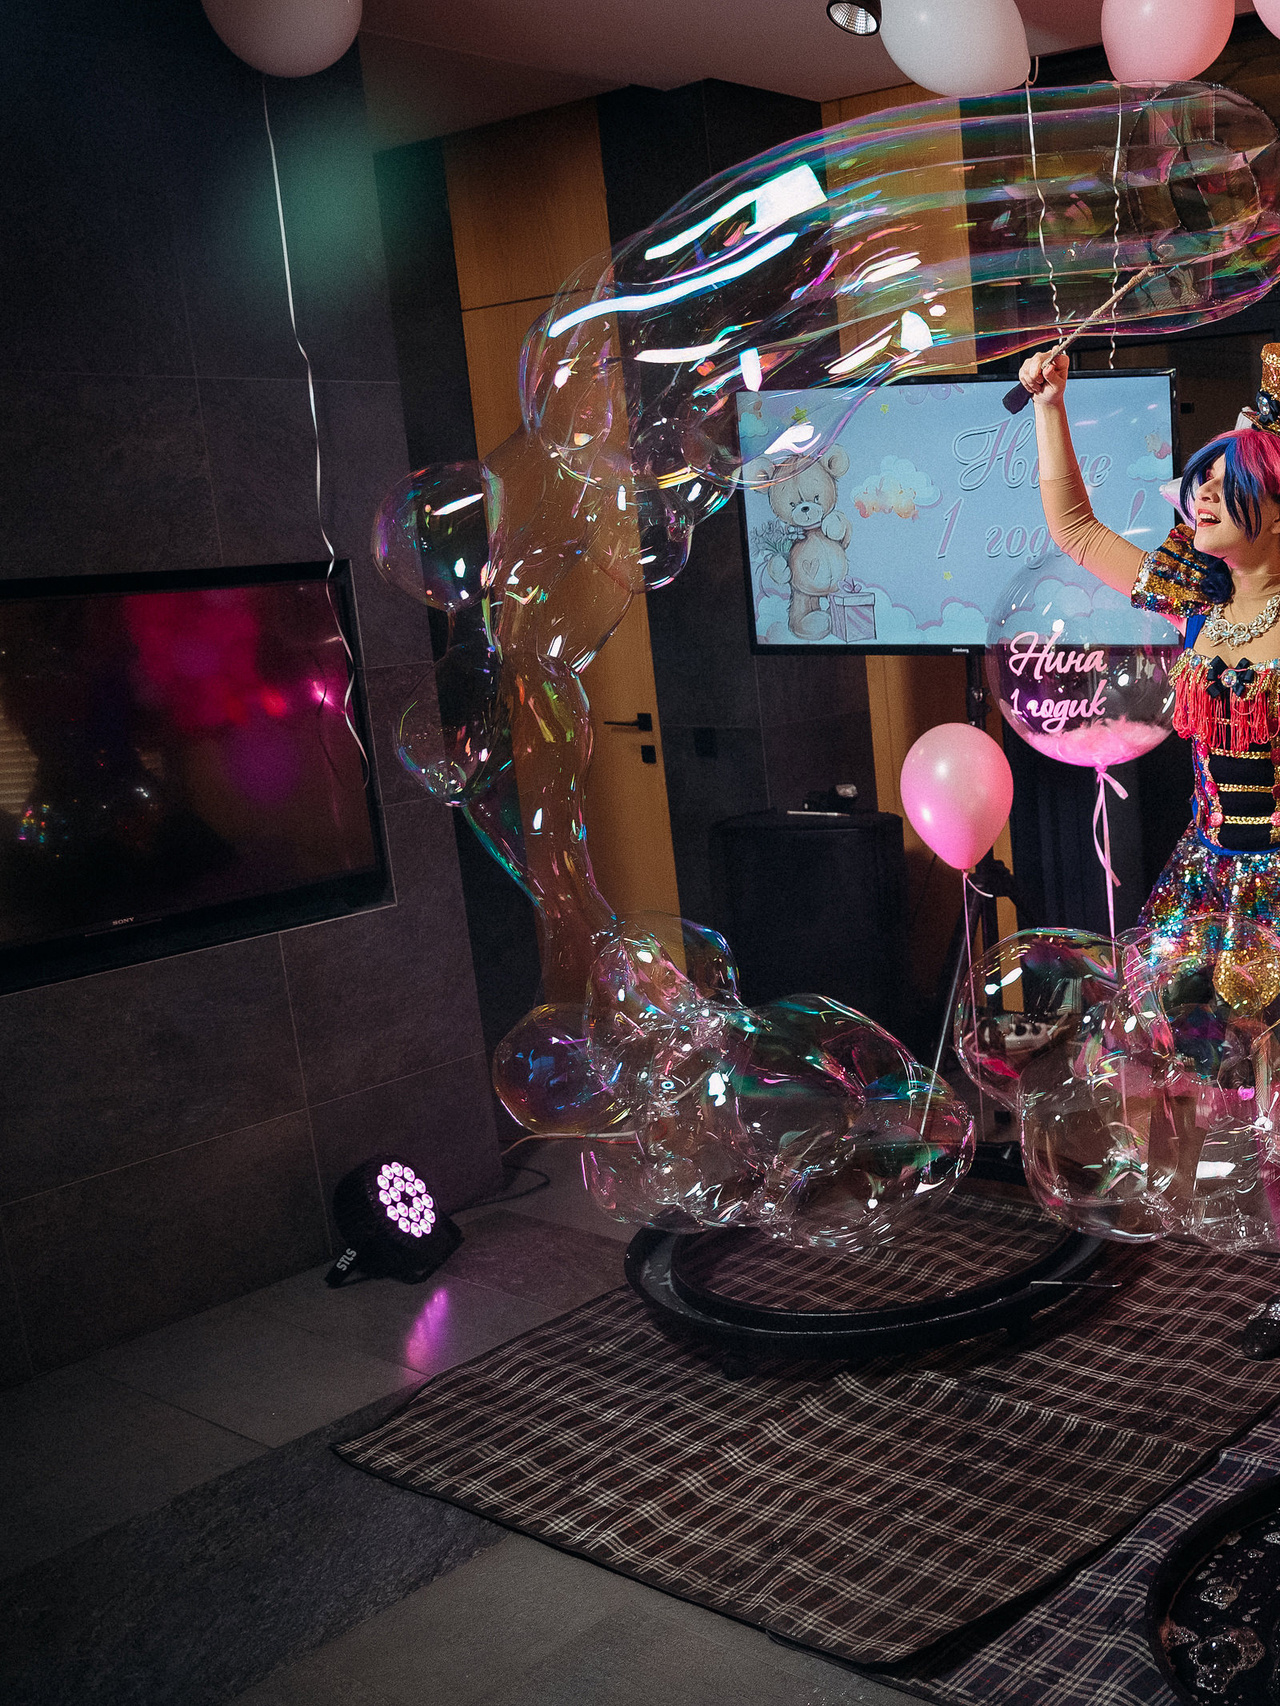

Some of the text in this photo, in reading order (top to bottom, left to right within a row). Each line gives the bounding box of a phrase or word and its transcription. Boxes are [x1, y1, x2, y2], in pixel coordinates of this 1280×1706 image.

[937, 498, 964, 560] 1
[1008, 630, 1108, 680] Нина
[1010, 679, 1108, 733] 1 годик
[112, 916, 135, 926] SONY
